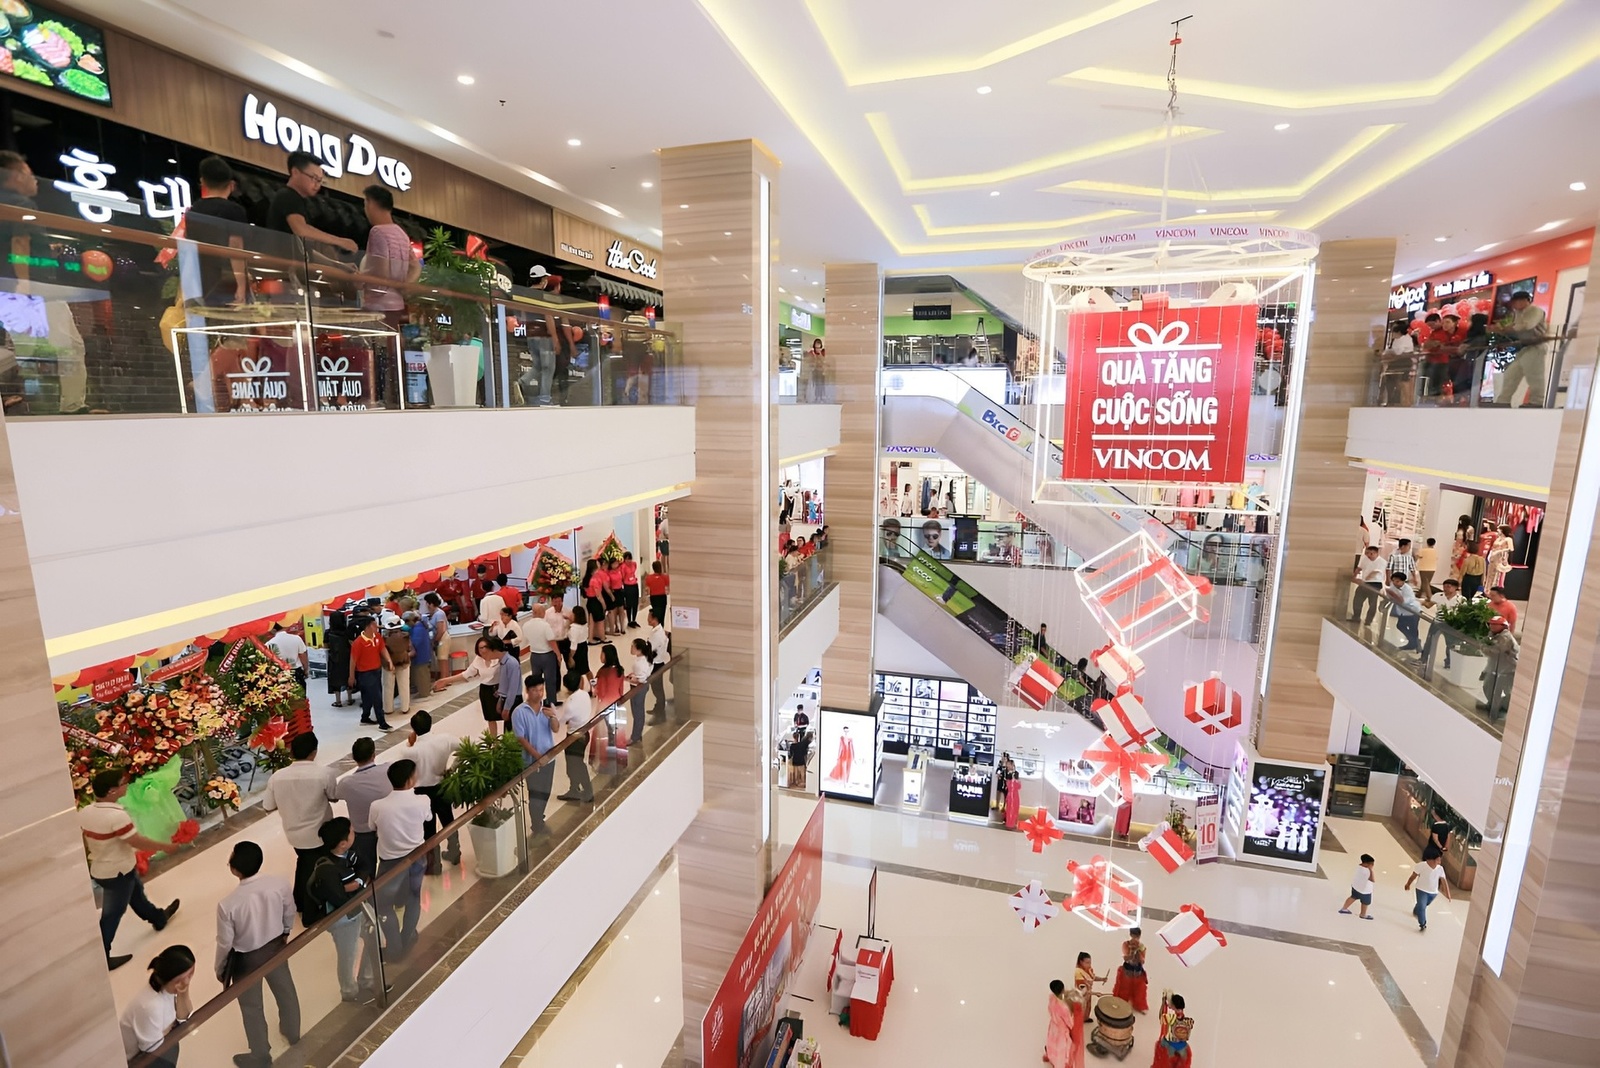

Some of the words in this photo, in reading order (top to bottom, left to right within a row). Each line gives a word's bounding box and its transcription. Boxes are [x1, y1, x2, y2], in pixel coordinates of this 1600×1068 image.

[243, 93, 343, 179] Hong
[347, 133, 412, 192] Dae
[1099, 233, 1136, 244] VINCOM
[1155, 228, 1195, 238] VINCOM
[1210, 226, 1249, 236] VINCOM
[1101, 352, 1147, 388] QUÀ
[1151, 351, 1213, 389] TẶNG
[1091, 391, 1151, 431] CUỘC
[1155, 390, 1218, 426] SỐNG
[1092, 447, 1213, 471] VINCOM
